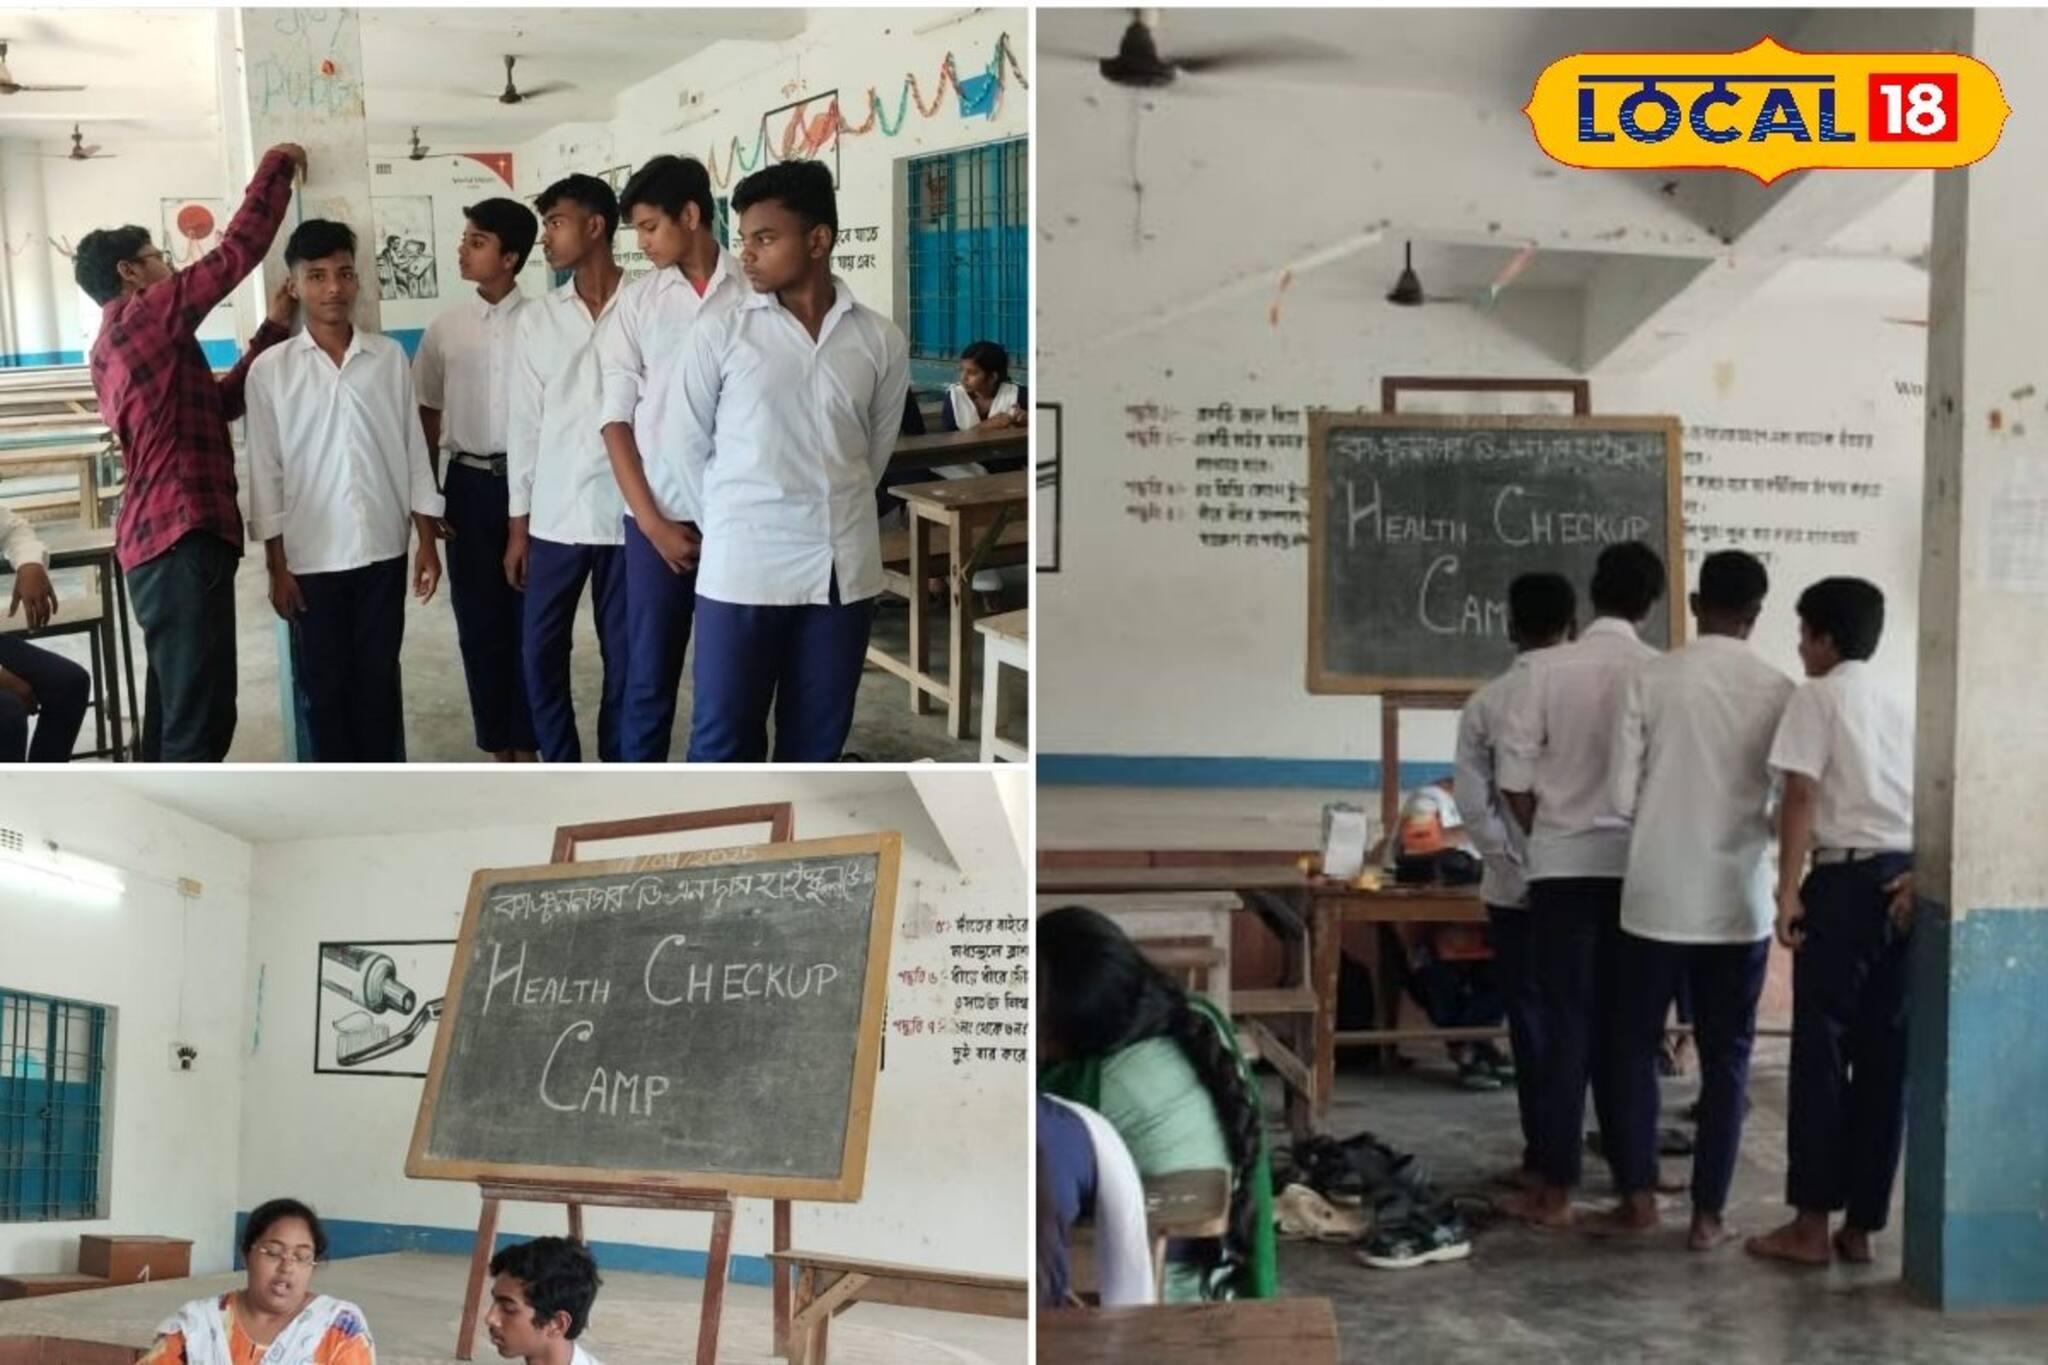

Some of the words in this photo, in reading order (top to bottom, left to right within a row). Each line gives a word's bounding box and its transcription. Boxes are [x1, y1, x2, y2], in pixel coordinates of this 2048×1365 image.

[1347, 480, 1467, 547] HEALTH
[1494, 483, 1650, 546] CHECKUP
[1420, 555, 1509, 635] CAM
[482, 941, 611, 1016] HEALTH
[644, 934, 838, 1006] CHECKUP
[540, 1020, 670, 1117] CAMP
